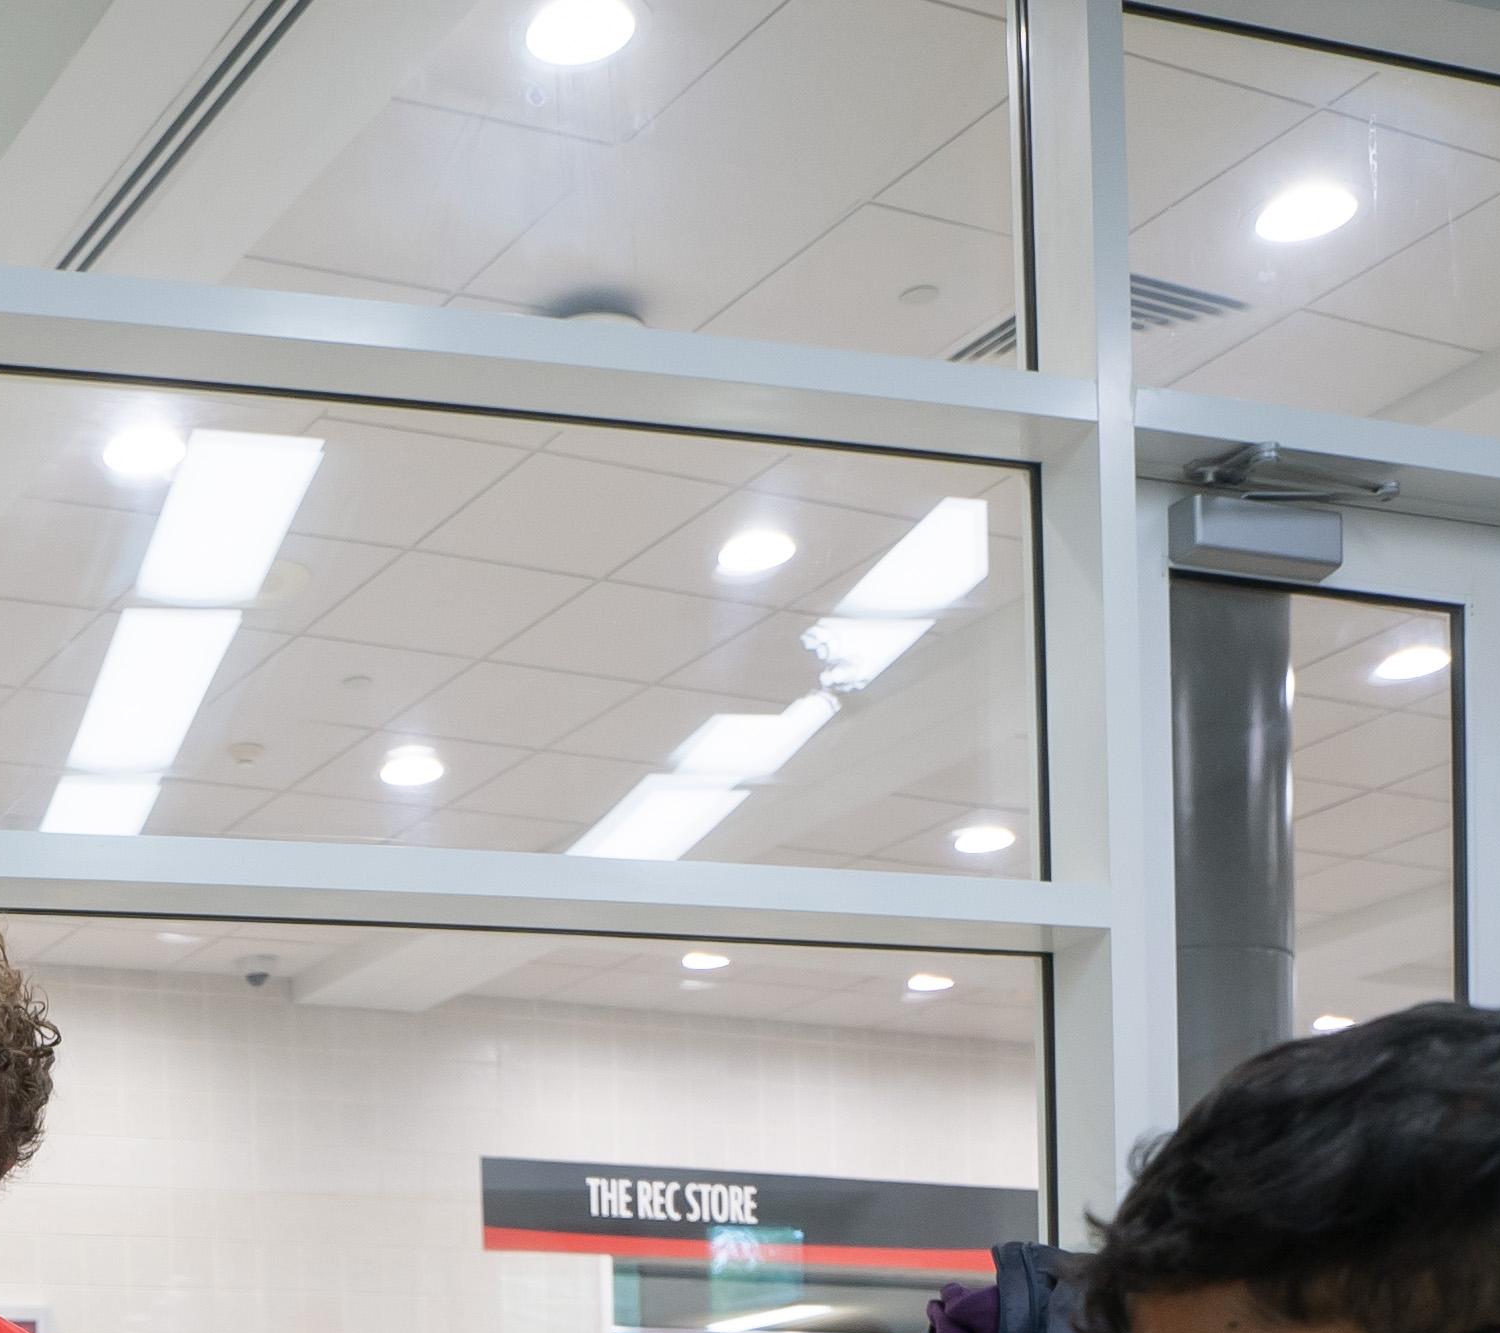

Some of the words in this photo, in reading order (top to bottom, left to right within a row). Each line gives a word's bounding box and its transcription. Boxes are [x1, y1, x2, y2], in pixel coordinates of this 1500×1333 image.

[585, 1177, 634, 1218] THE
[637, 1180, 682, 1222] REC
[684, 1182, 759, 1224] STORE
